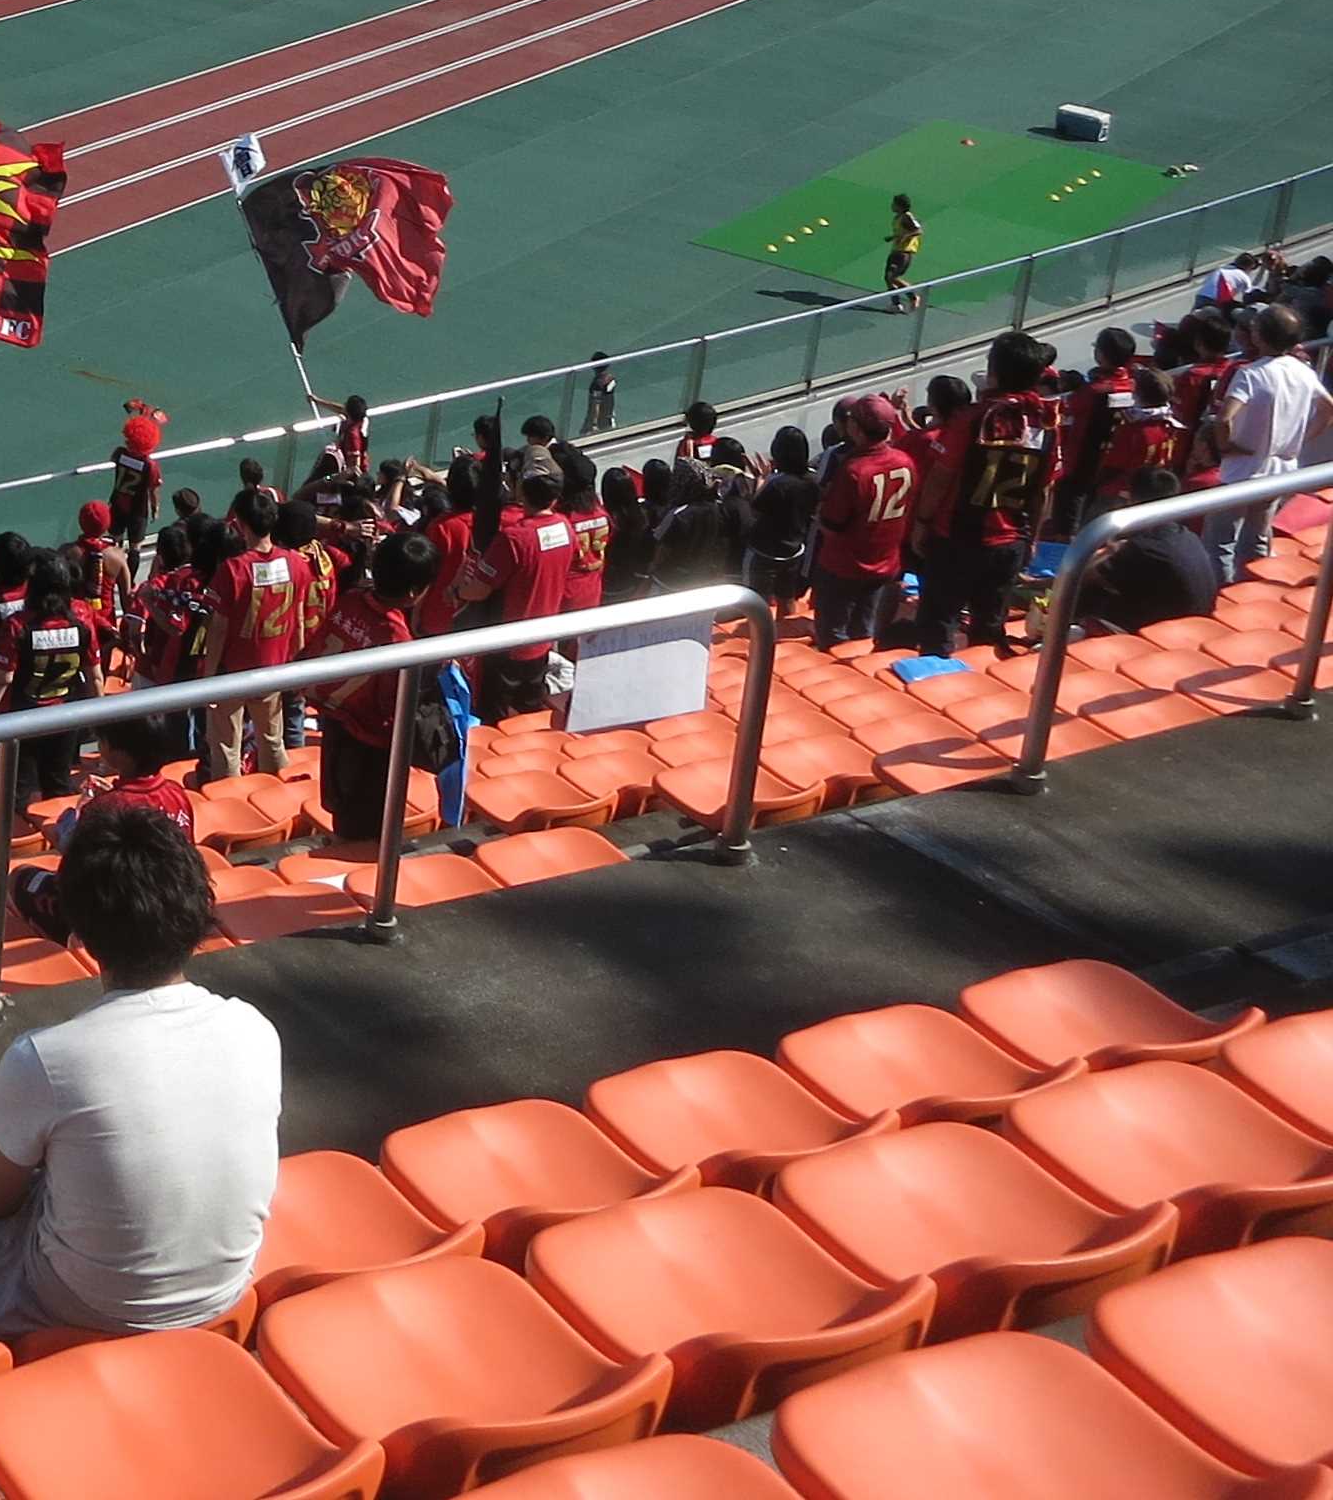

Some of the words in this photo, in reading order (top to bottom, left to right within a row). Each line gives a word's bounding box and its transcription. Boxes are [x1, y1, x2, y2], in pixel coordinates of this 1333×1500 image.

[0, 317, 33, 342] FC
[866, 466, 915, 524] 12
[240, 581, 294, 638] 12
